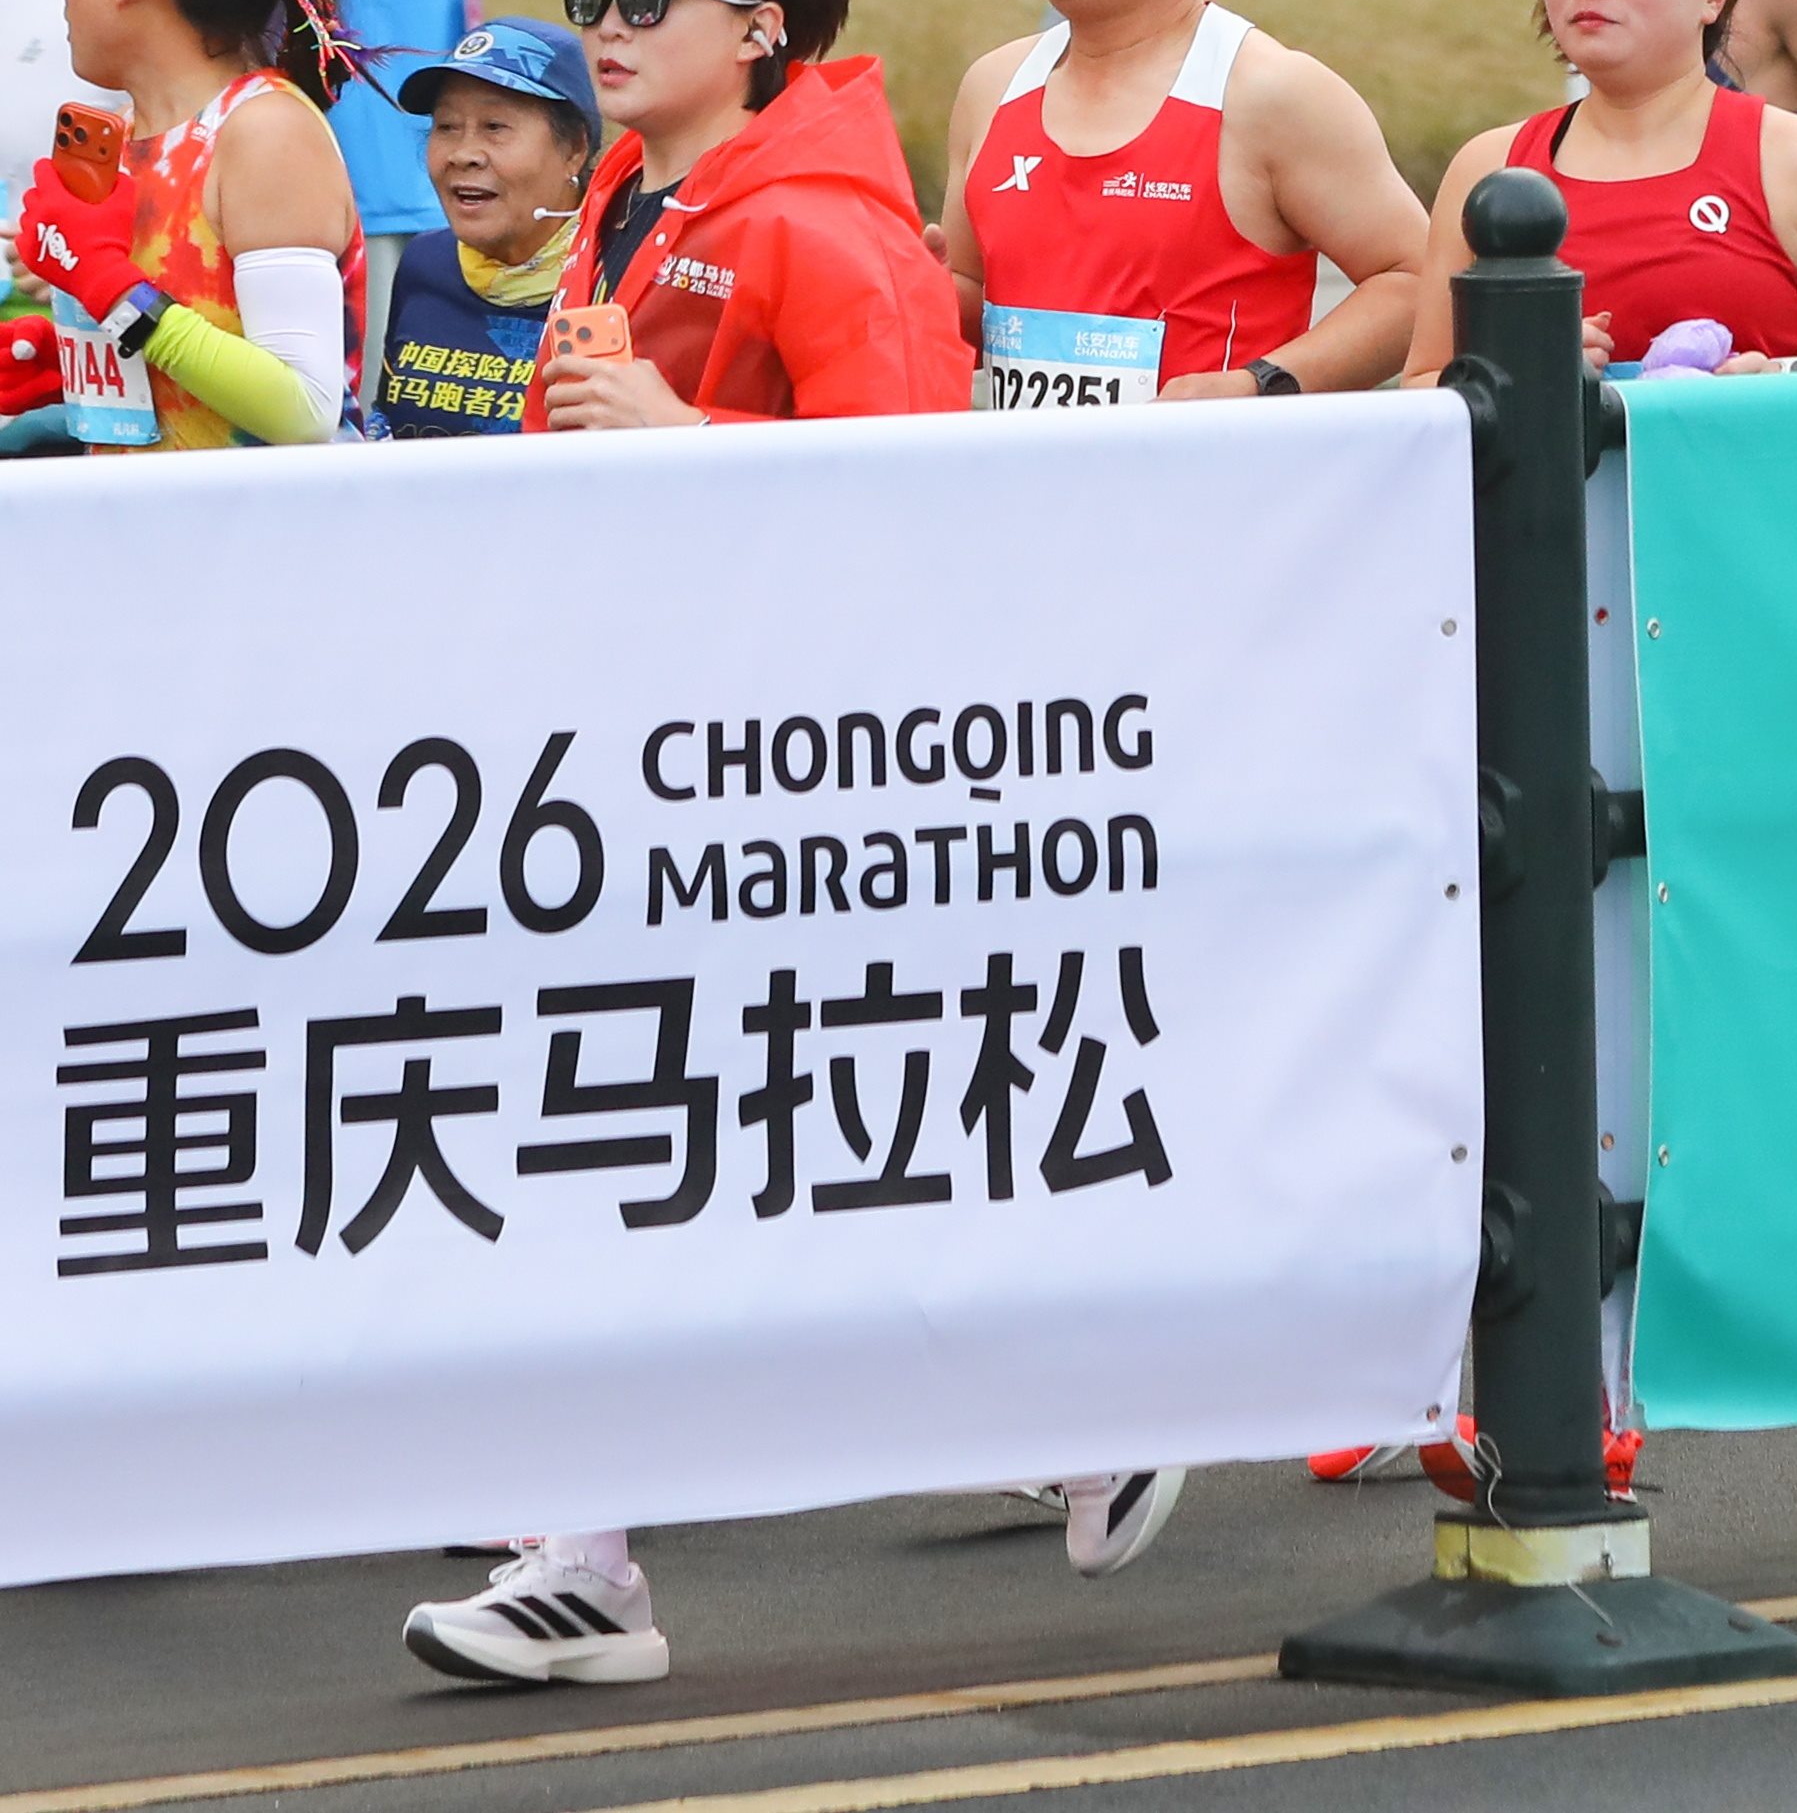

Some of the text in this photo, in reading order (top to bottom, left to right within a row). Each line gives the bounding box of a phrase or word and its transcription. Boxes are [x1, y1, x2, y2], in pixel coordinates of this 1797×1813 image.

[1075, 346, 1138, 360] CHANGAN
[1076, 330, 1140, 349] 长安汽车
[71, 730, 606, 965] 2026
[55, 944, 1175, 1279] 重庆马拉松
